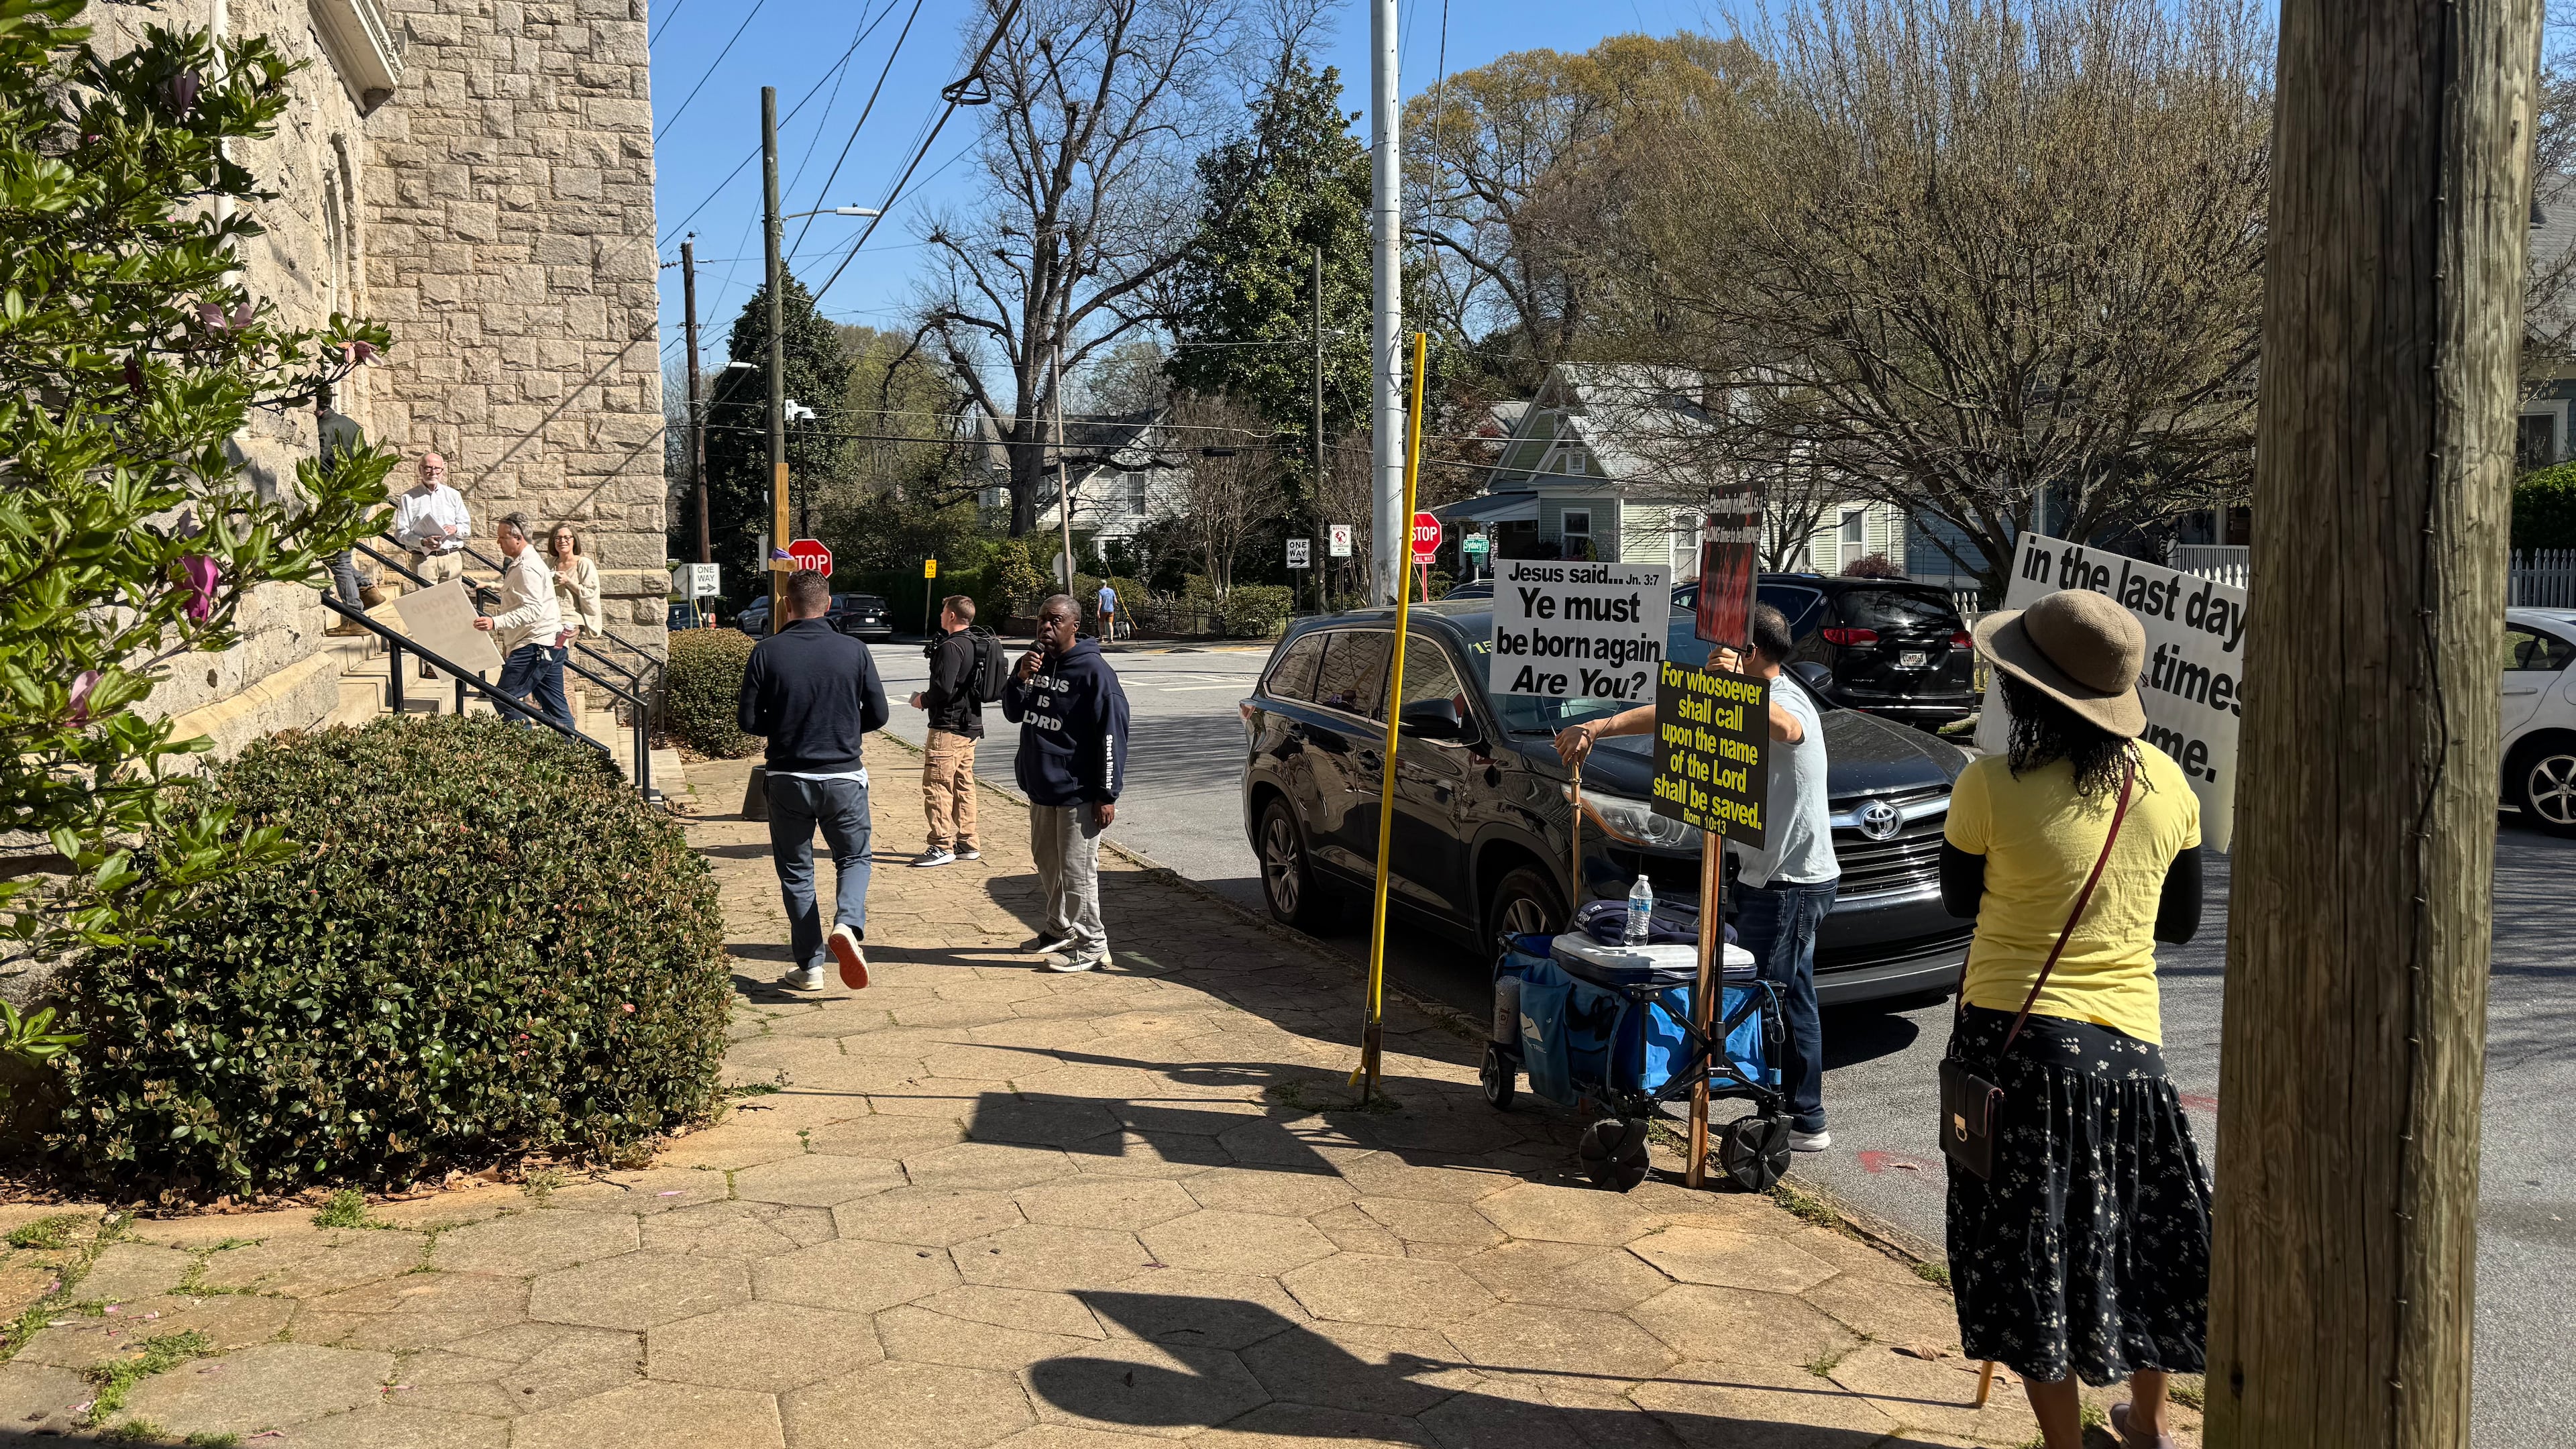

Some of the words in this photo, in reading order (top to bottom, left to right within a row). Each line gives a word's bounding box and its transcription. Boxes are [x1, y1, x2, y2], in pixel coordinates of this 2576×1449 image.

[1709, 493, 1733, 519] Eternity
[1732, 492, 1739, 513] in
[1737, 491, 1754, 515] HELL
[1754, 491, 1759, 513] is
[1759, 496, 1763, 513] a
[1412, 526, 1438, 541] STOP
[1464, 541, 1483, 551] Sydney
[1706, 526, 1721, 543] LONG
[1720, 526, 1731, 543] time
[1730, 527, 1735, 543] to
[1735, 526, 1742, 543] be
[795, 554, 828, 570] TOP
[1508, 562, 1564, 583] Jesus
[1569, 564, 1623, 584] said...
[1625, 574, 1641, 585] Jn.
[1644, 574, 1660, 586] 3:7
[2022, 535, 2051, 584] in
[2059, 545, 2110, 596] the
[2116, 559, 2180, 621] last
[1517, 586, 1556, 619] Ye
[1564, 591, 1641, 623] must
[1497, 626, 1528, 655] be
[1532, 627, 1590, 659] born
[1593, 633, 1660, 668] again
[1510, 665, 1568, 695] Are
[1579, 668, 1648, 700] You?
[1661, 661, 1684, 688] For
[1686, 667, 1762, 705] whosoever
[1037, 694, 1051, 707] IS
[1678, 694, 1712, 724] shall
[1715, 705, 1743, 732] call
[1022, 710, 1062, 731] LORD
[1662, 722, 1692, 749] upon
[1695, 726, 1717, 754] the
[1719, 737, 1758, 765] name
[1670, 750, 1684, 773] of
[1687, 753, 1709, 782] the
[1713, 759, 1747, 793] Lord
[1653, 773, 1687, 805] shall
[1690, 782, 1708, 812] be
[1712, 795, 1762, 830] saved.
[1683, 808, 1701, 826] Rom
[1704, 814, 1727, 835] 10:13
